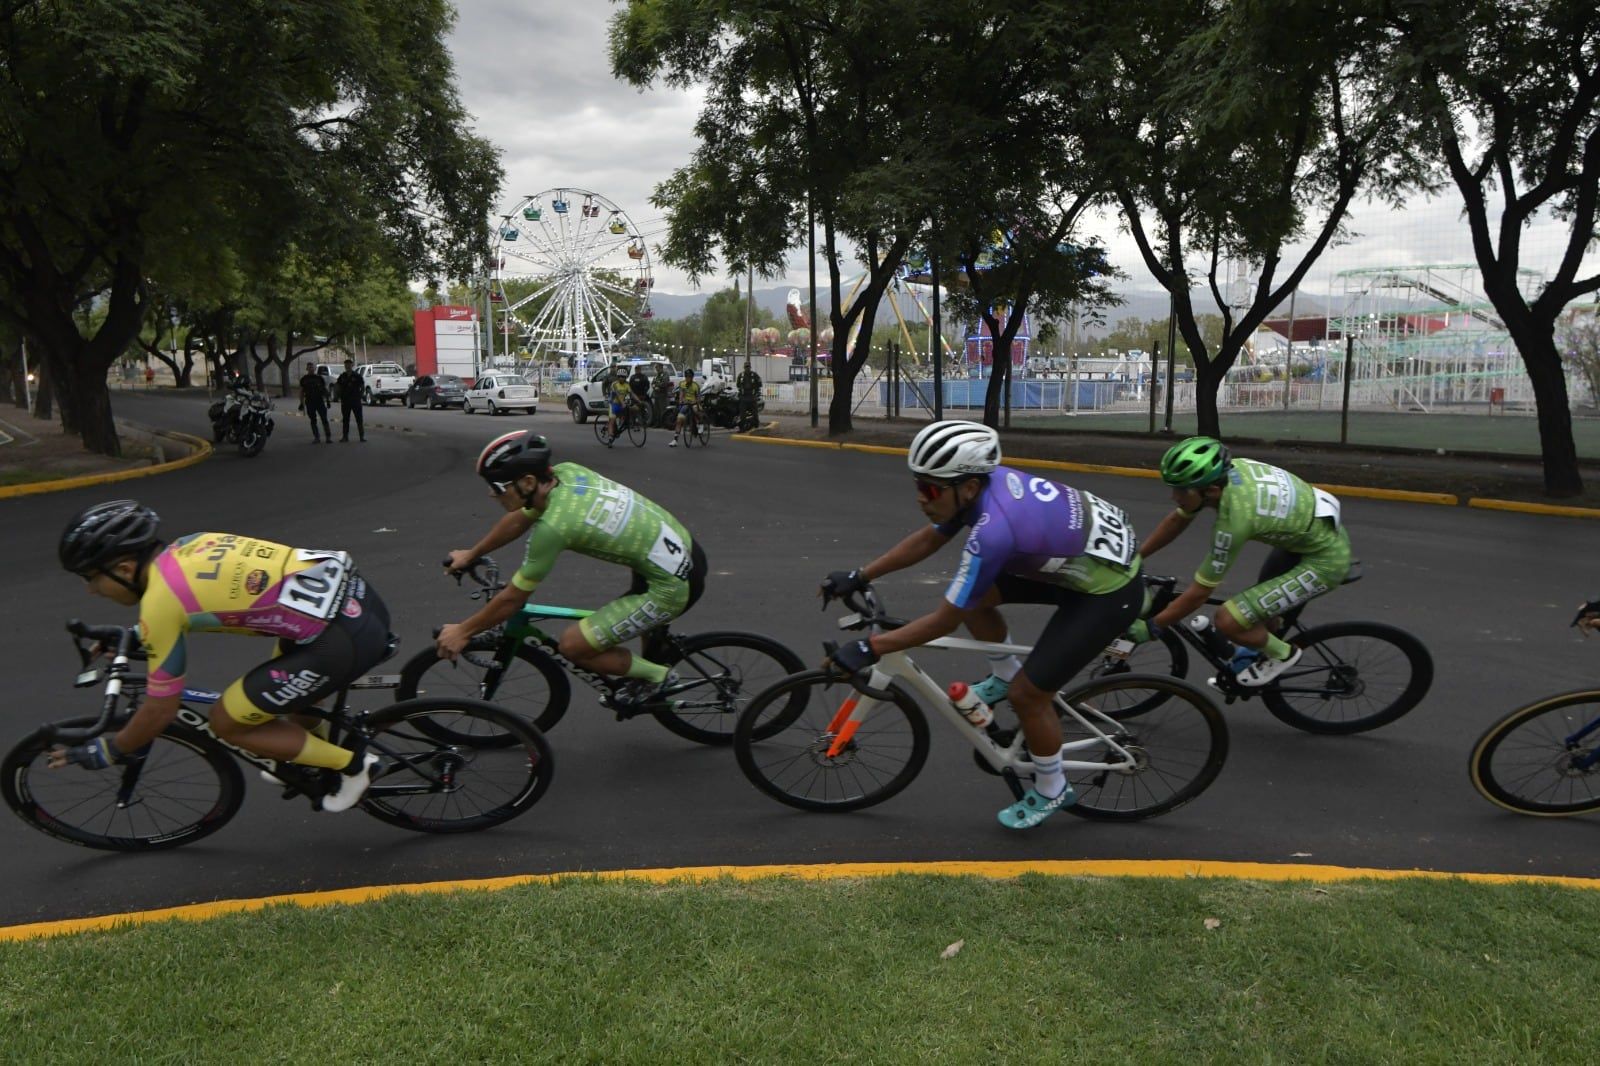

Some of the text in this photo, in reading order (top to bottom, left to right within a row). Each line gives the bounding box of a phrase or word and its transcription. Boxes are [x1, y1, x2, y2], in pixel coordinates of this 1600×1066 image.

[662, 537, 682, 556] 4
[1260, 570, 1320, 616] SEP
[262, 669, 322, 706] Luján
